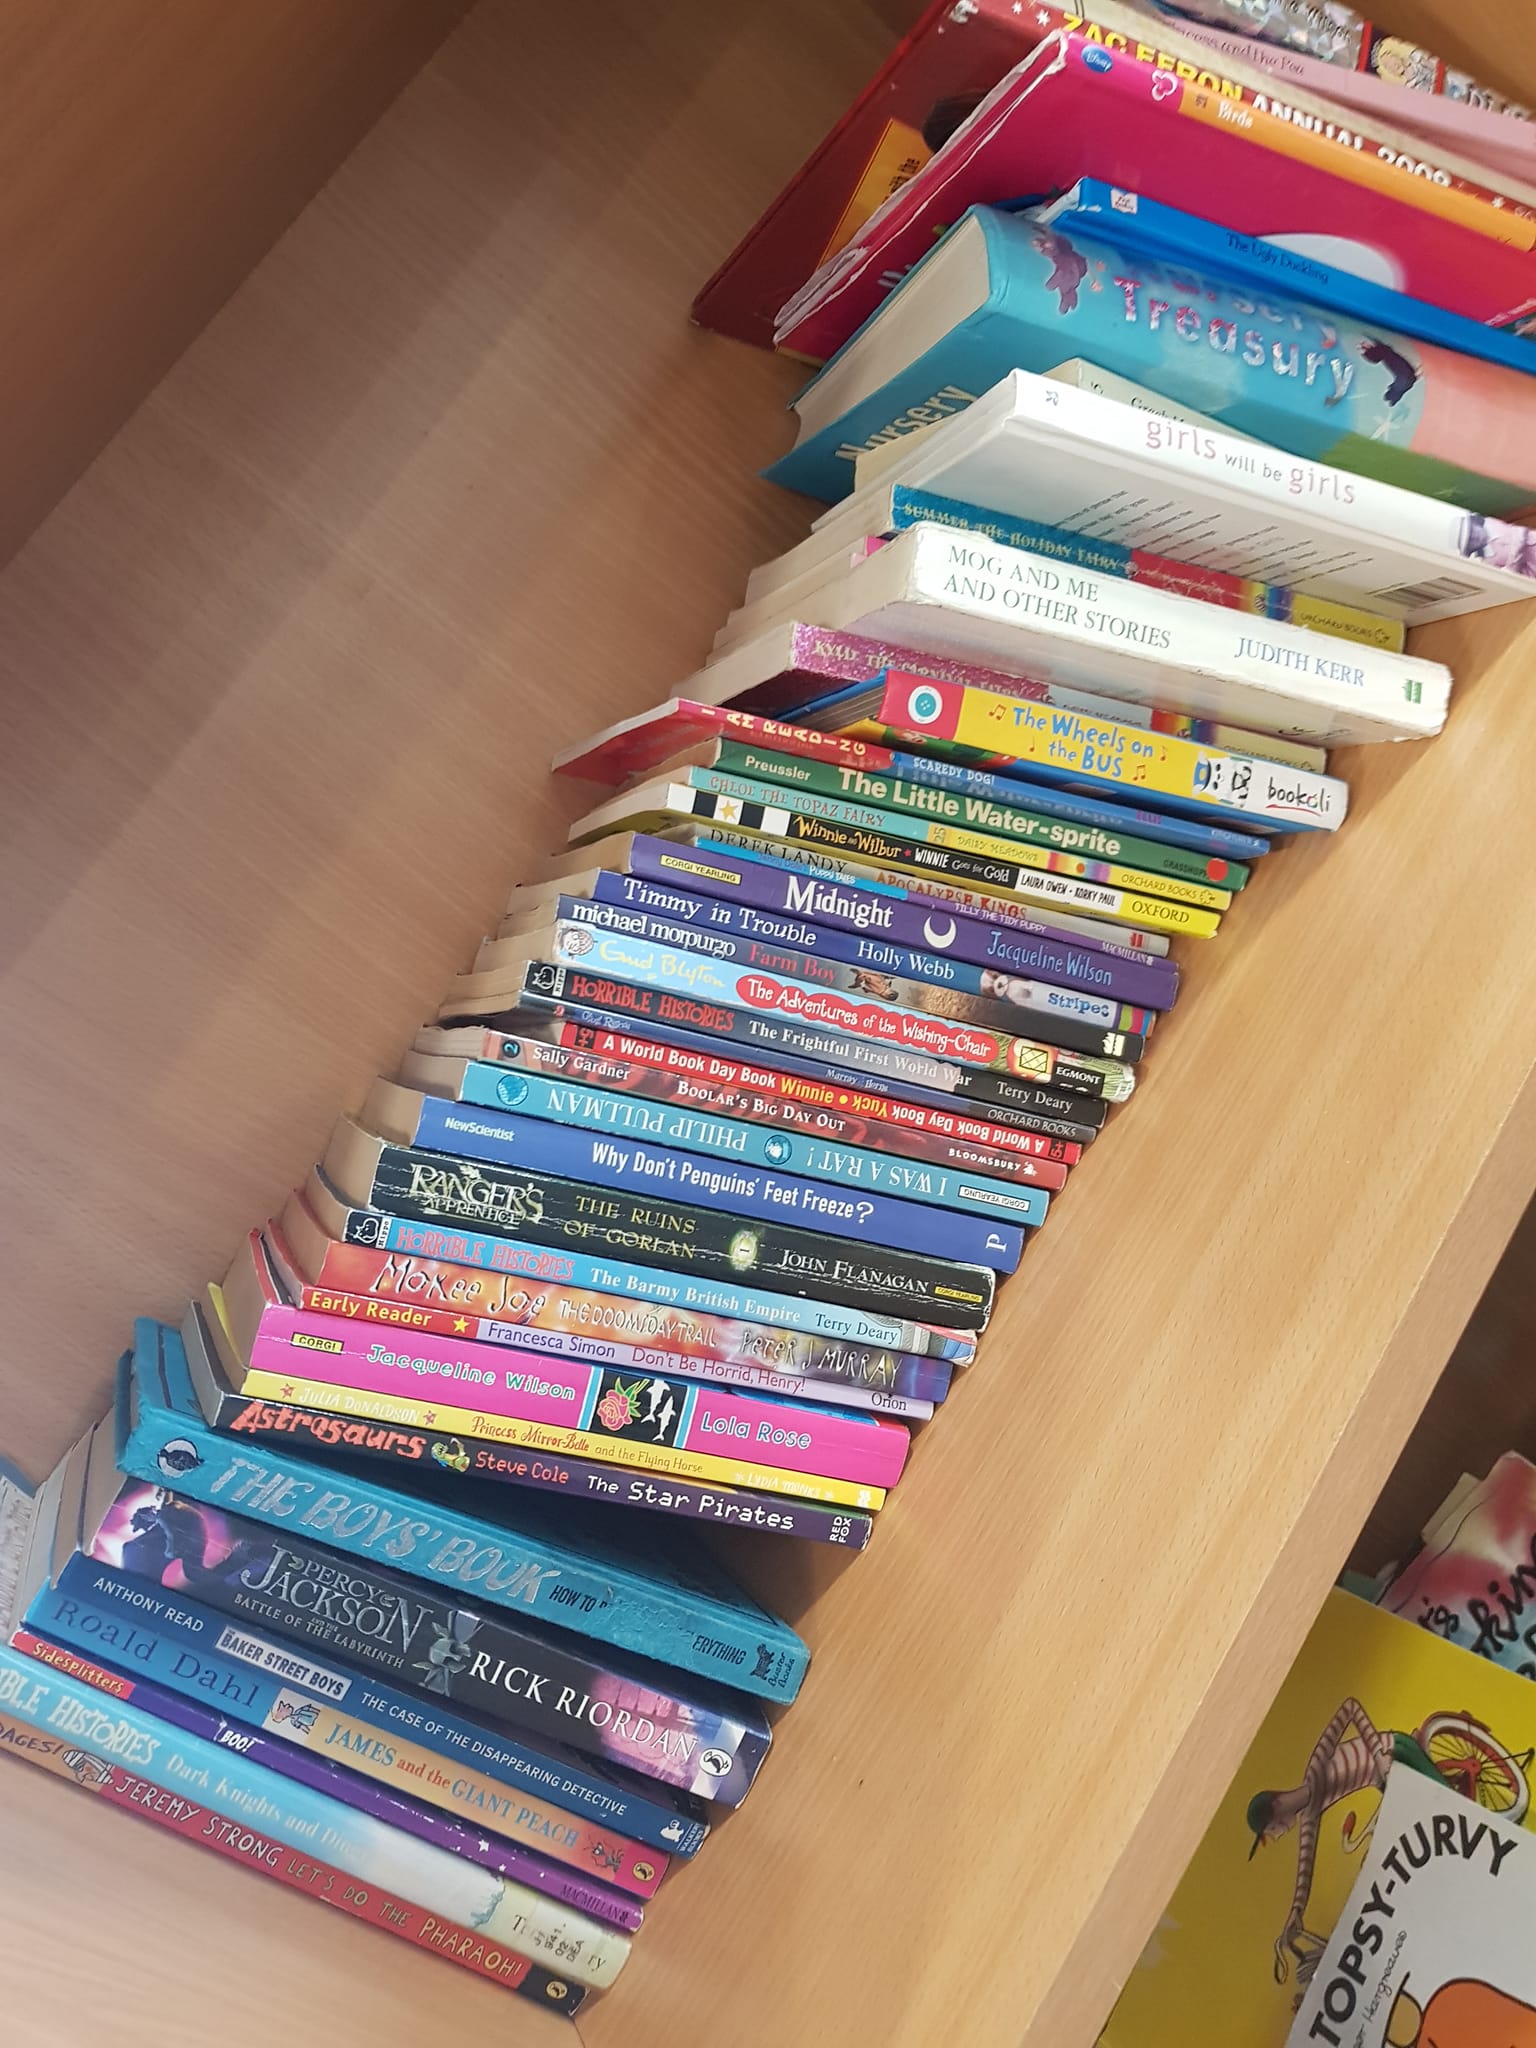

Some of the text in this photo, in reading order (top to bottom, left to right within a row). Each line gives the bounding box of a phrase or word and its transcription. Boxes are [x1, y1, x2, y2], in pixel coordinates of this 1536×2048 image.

[1058, 10, 1131, 54] ZAC
[1096, 274, 1357, 412] Treasury
[1141, 416, 1359, 510] girls will be girls
[947, 544, 1005, 576] MOG
[1009, 562, 1062, 592] AND
[1065, 577, 1101, 603] ME
[942, 572, 1173, 651] AND OTHER STORIES
[1233, 635, 1367, 688] JUDITH KERR
[761, 720, 867, 756] READING
[1009, 705, 1048, 732] The
[1047, 710, 1129, 754] Wheels
[1129, 740, 1155, 759] on
[1047, 735, 1126, 779] the BUS
[911, 757, 962, 779] SCAREDY
[742, 753, 812, 783] Preussler
[833, 765, 889, 799] The
[889, 780, 961, 818] Little
[960, 797, 1123, 861] Water-sprite
[790, 794, 838, 818] TOPAZ
[708, 828, 777, 857] DEREK
[790, 814, 903, 860] Winnie Wilbur
[663, 857, 694, 872] CORGI
[1019, 872, 1045, 889] LAURA
[1119, 871, 1166, 892] ORCHARD
[619, 876, 957, 980] Timmy in Trouble Holly Webb
[781, 874, 898, 935] Midnight
[952, 903, 980, 917] TILLY
[1129, 899, 1190, 925] OXFORD
[570, 899, 838, 985] michael morpurgo Farm Boy
[983, 929, 1117, 987] Jacqueline Wilson
[1098, 941, 1148, 965] MACMILLAN
[655, 952, 729, 994] Blyton
[742, 977, 898, 1035] The Adventures the
[568, 972, 655, 1014] HORRIBLE
[655, 994, 736, 1032] HISTORIES
[746, 1019, 778, 1039] The
[779, 1027, 850, 1058] Frightful
[994, 1080, 1031, 1104] Terry
[1032, 1090, 1073, 1114] Deary
[531, 1046, 847, 1132] Sally Gardner DAY OUT
[617, 1040, 835, 1105] World Book Day Book Winnie
[1054, 1065, 1101, 1085] EGMONT
[545, 1087, 748, 1151] PHILIP PULLMAN
[986, 1106, 1041, 1130] ORCHARD
[992, 1128, 1031, 1150] World
[588, 1140, 800, 1206] Why Feet
[888, 1164, 935, 1193] WAS
[947, 1146, 1021, 1173] BLOOMSBURY
[404, 1157, 549, 1224] RANGER'S
[573, 1195, 697, 1235] THE RUINS
[561, 1217, 593, 1239] OF
[394, 1224, 899, 1343] HORRIBLE HISTORIES The British Empire Terry Deary
[486, 1273, 549, 1325] Joe
[776, 1247, 929, 1299] JOHN FLANAGAN
[308, 1290, 433, 1329] Early Reader
[297, 1335, 337, 1352] CORGI
[486, 1321, 698, 1372] Francesca Simon Be
[816, 1341, 903, 1389] MURRAY
[364, 1342, 813, 1451] Jacqueline Wilson Lola Rose
[869, 1391, 909, 1414] Orion
[229, 1395, 428, 1470] Astrosaurs
[594, 1441, 671, 1471] and Flying
[209, 1451, 316, 1526] THE
[473, 1449, 797, 1532] Steve Cole The Star Pirates
[829, 1516, 842, 1542] RED
[837, 1516, 853, 1544] FOX
[91, 1576, 206, 1634] ANTHONY READ
[232, 1592, 282, 1621] BATTLE
[234, 1533, 437, 1659] JACKSON
[301, 1559, 384, 1605] PERCY
[548, 1582, 583, 1610] HOW
[28, 1640, 128, 1695] Sidesplitters
[261, 1649, 346, 1697] STREET BOYS
[690, 1631, 748, 1668] ERYTHING
[167, 1649, 262, 1709] Dahl
[43, 1691, 166, 1770] HISTORIES
[467, 1649, 700, 1763] RICK RIORDAN
[359, 1691, 629, 1817] THE CASE OF THE DISAPPEARING DETECTIVE
[324, 1721, 582, 1849] JAMES and the GIANT PEACH
[112, 1772, 202, 1826] JEREMY
[200, 1813, 284, 1866] STRONG
[1308, 1813, 1519, 2048] TOPSY-TURVY
